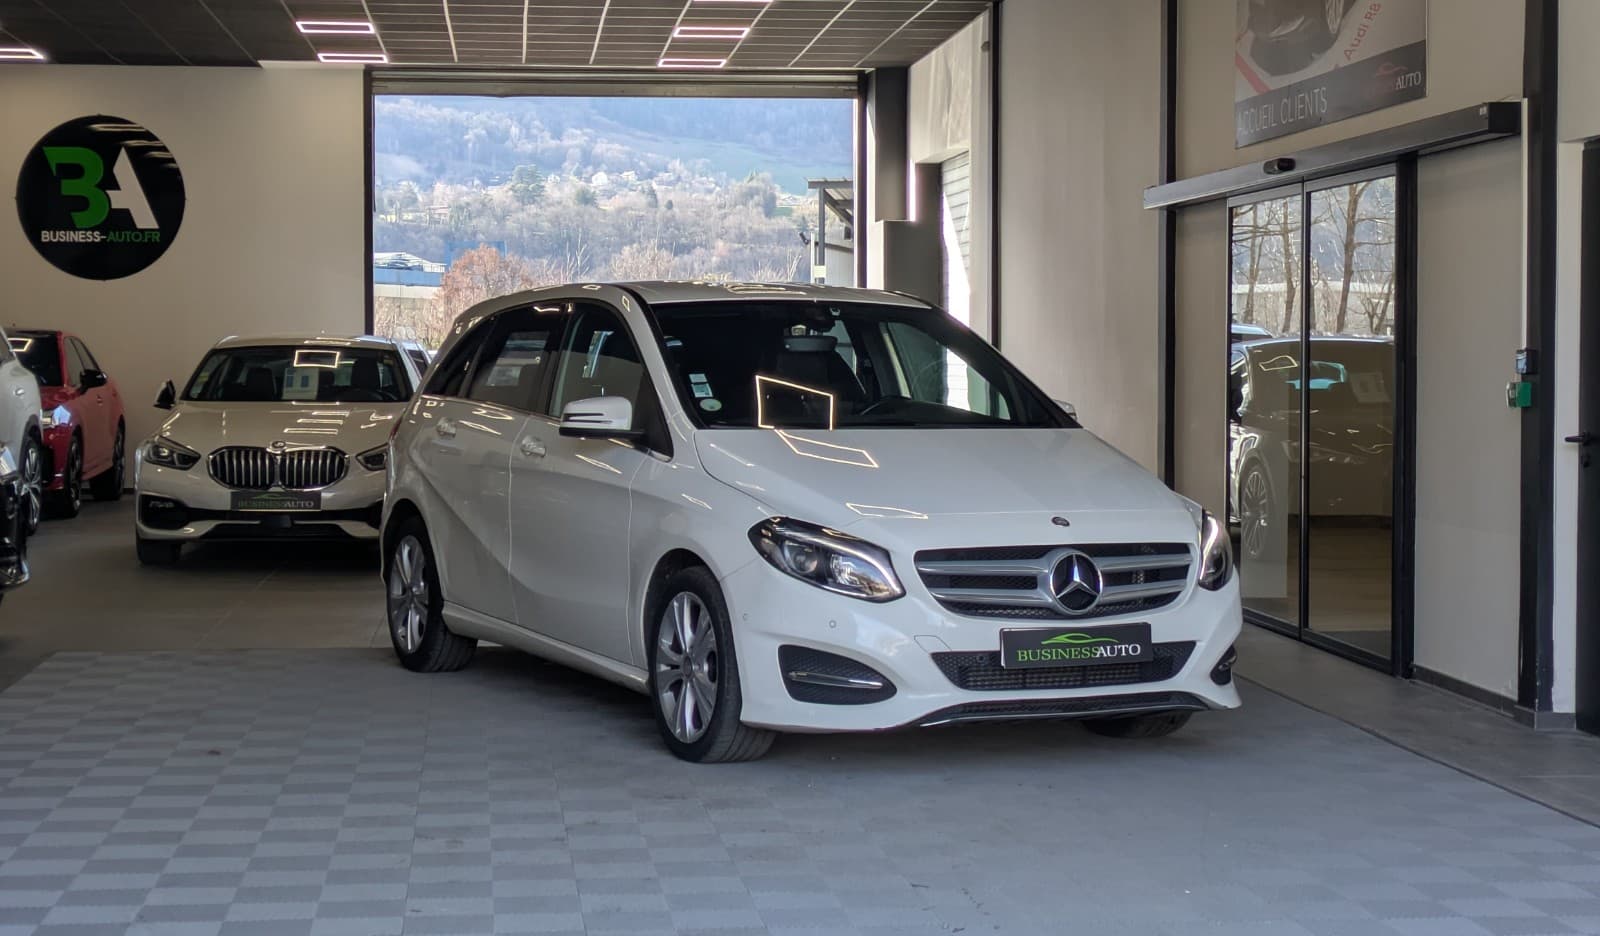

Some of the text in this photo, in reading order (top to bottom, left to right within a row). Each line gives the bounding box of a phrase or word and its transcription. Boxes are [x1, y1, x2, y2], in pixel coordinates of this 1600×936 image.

[1343, 22, 1369, 61] Audi
[1395, 71, 1422, 90] AUTO
[1237, 104, 1278, 137] ACCUEIL
[1280, 87, 1328, 125] CLIENTS
[41, 230, 161, 243] BUSINESS-AUTO.FR
